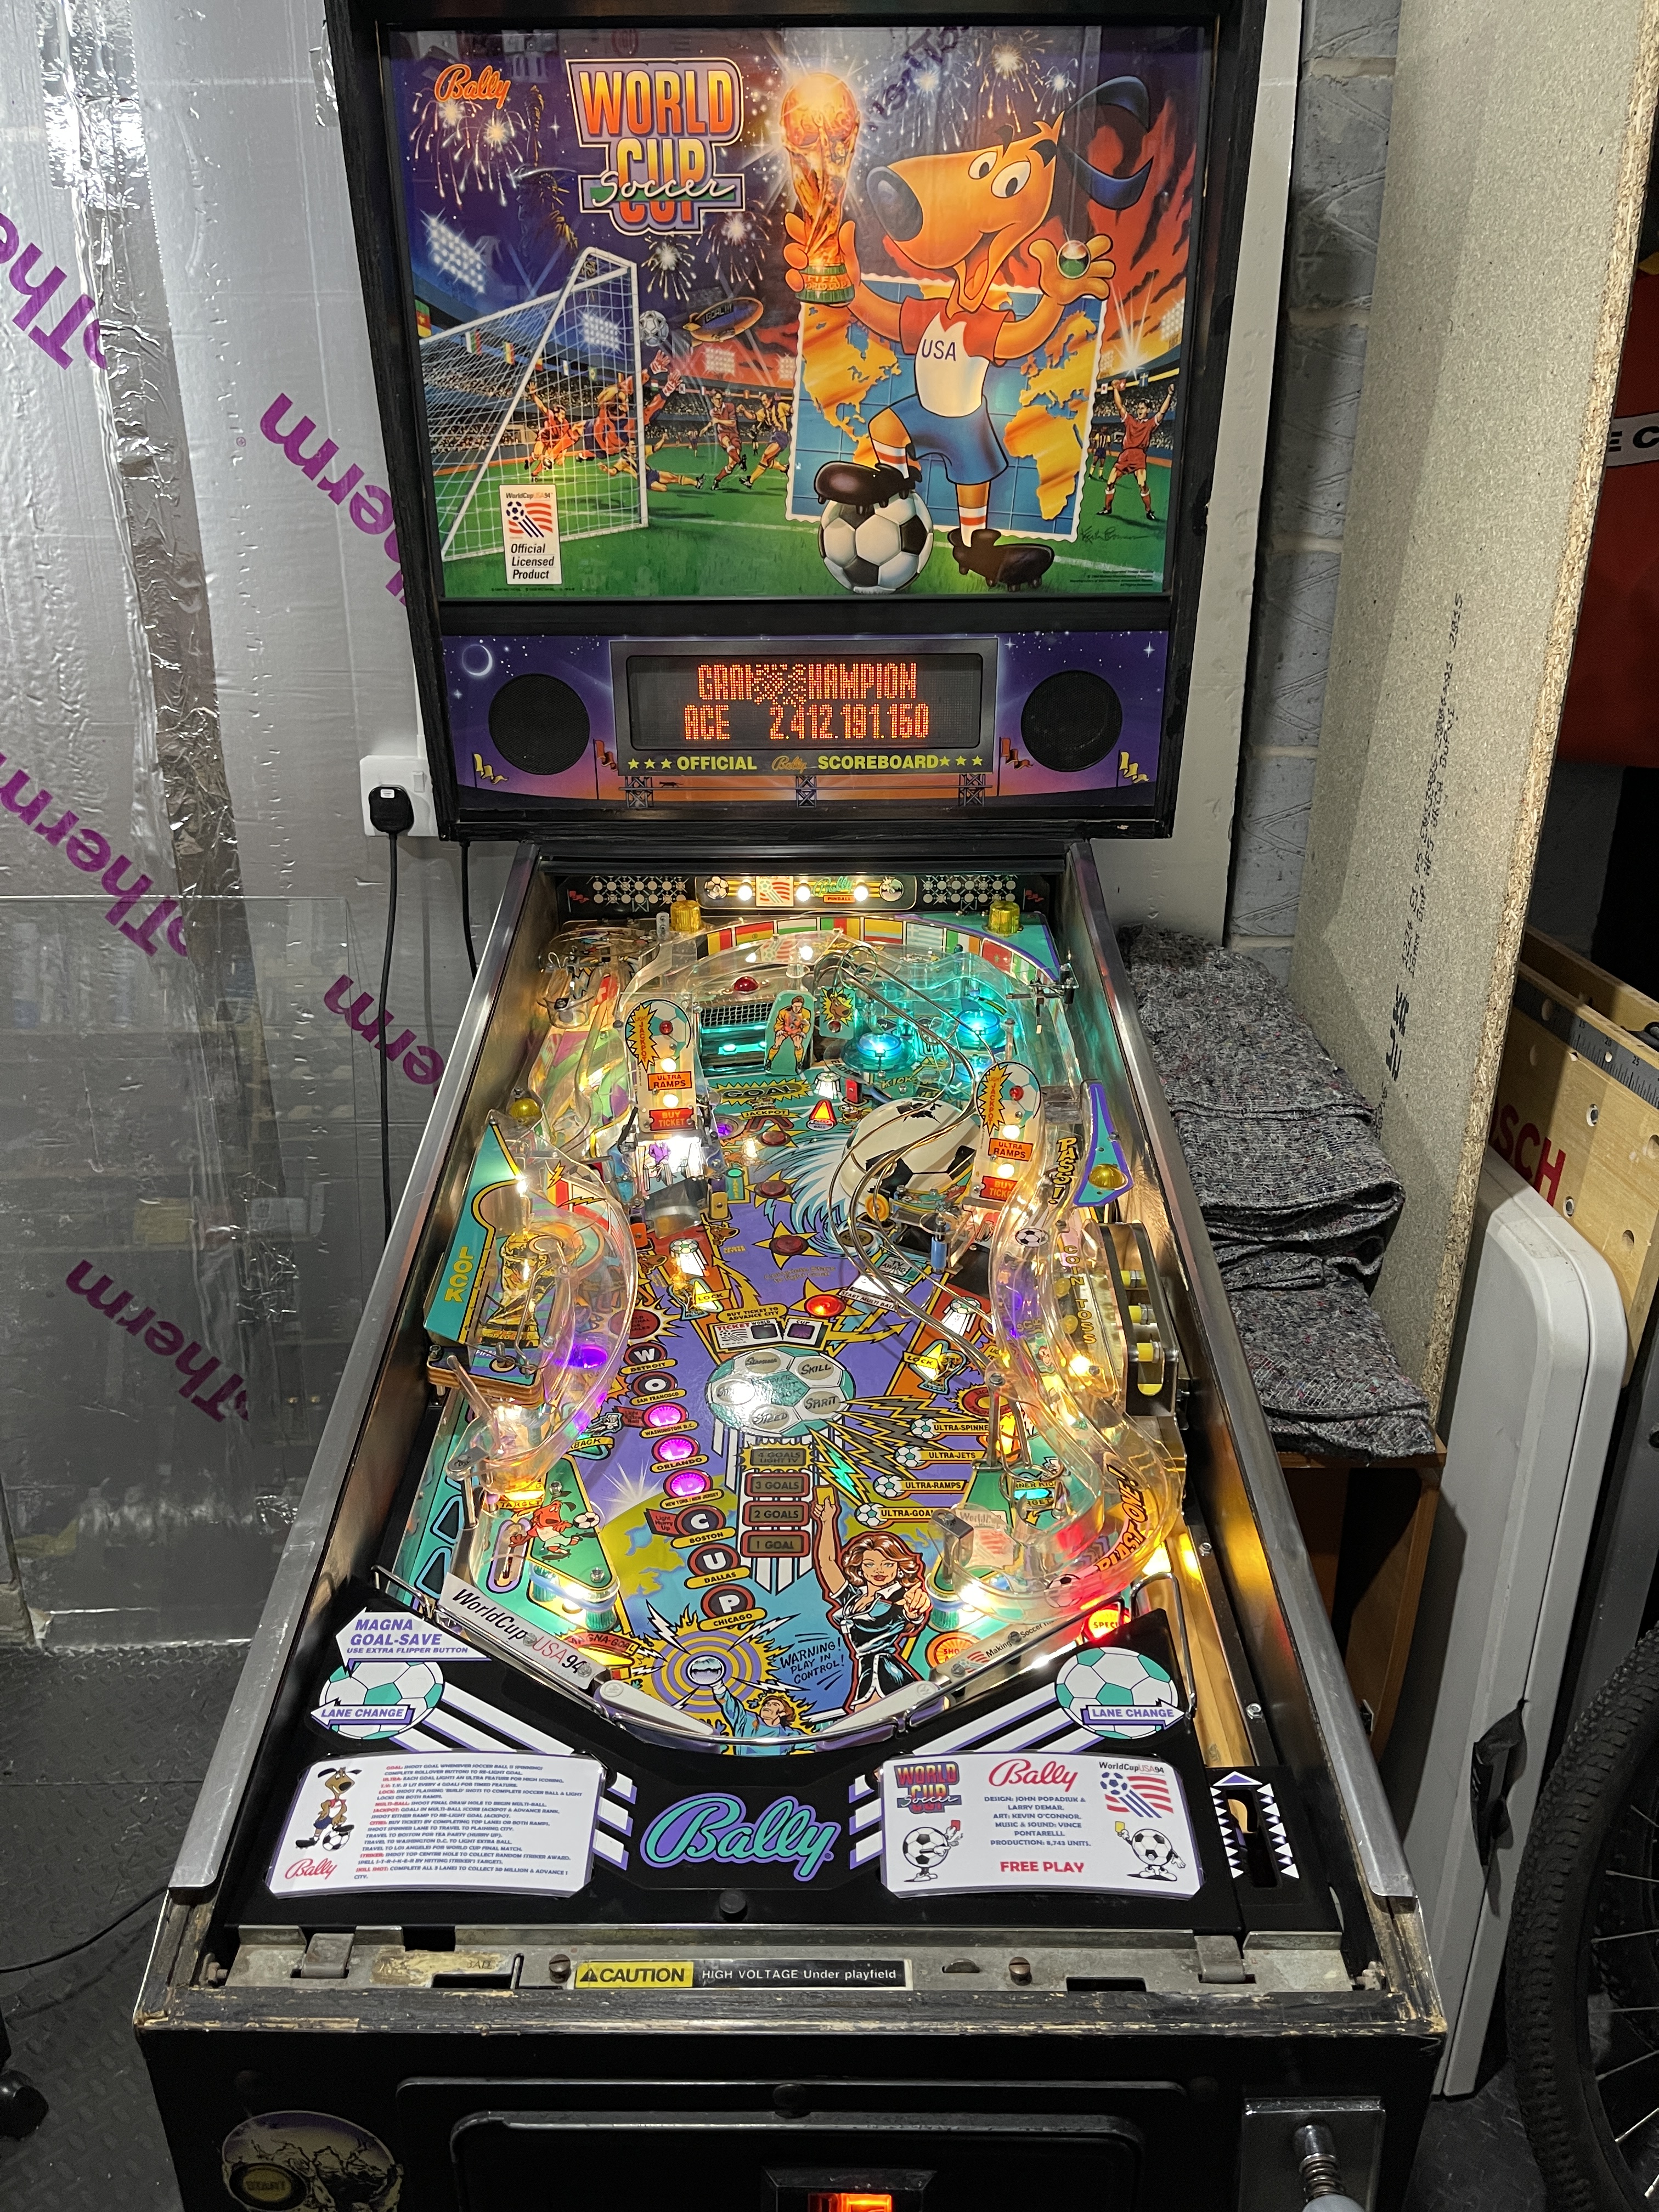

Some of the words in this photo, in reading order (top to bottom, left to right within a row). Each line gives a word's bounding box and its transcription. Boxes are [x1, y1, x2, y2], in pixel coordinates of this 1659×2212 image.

[435, 64, 511, 109] Bally
[578, 70, 734, 136] WORLD
[616, 138, 706, 223] CUP
[592, 171, 737, 207] Soccer
[804, 281, 827, 291] ORLD
[921, 338, 957, 362] USA
[511, 543, 546, 554] Official
[512, 556, 555, 566] Licensed
[512, 569, 549, 579] Product
[685, 704, 730, 740] ACE
[769, 703, 929, 740] 2.412.191.150
[677, 757, 757, 770] OFFICIAL
[771, 755, 806, 773] Bally
[818, 755, 939, 770] SCOREBOARD
[813, 876, 854, 897] Bally
[1579, 1020, 1585, 1029] 15
[639, 1022, 648, 1063] JACKPOT
[1604, 1037, 1612, 1047] 20
[1632, 1056, 1640, 1066] 25
[653, 1080, 686, 1088] RAMPS
[723, 1085, 797, 1099] GOAL
[989, 1083, 997, 1125] JACKPOT
[658, 1118, 686, 1127] TICKET
[998, 1141, 1023, 1150] ULTRA
[1489, 1097, 1566, 1207] SCH
[994, 1148, 1026, 1159] RAMPS
[1048, 1137, 1078, 1205] PASS!
[994, 1181, 1014, 1190] BUY
[882, 1263, 906, 1272] AWARD
[1063, 1244, 1085, 1286] COIN
[444, 1246, 473, 1303] LOCK
[697, 1292, 724, 1301] LOCK
[840, 1291, 860, 1302] START
[860, 1296, 879, 1306] MULTI
[1075, 1298, 1097, 1345] TOSS
[634, 1348, 655, 1363] W
[907, 1355, 934, 1366] LOCK
[630, 1362, 665, 1372] DETROIT
[801, 1364, 831, 1375] SKILL
[645, 1378, 666, 1392] O
[650, 1392, 679, 1402] FRANCISCO
[805, 1396, 838, 1409] SPIRIT
[645, 1426, 682, 1436] WASHINGTON
[656, 1457, 703, 1470] ORLANDO
[755, 1481, 761, 1489] 3
[765, 1481, 799, 1489] GOALS
[754, 1510, 760, 1519] 2
[764, 1510, 799, 1519] GOALS
[881, 1509, 933, 1517] ULTRA-GOA
[690, 1513, 709, 1530] C
[690, 1531, 724, 1544] BOSTON
[765, 1541, 794, 1549] GOAL
[703, 1551, 726, 1571] U
[703, 1571, 737, 1583] DALLAS
[718, 1594, 740, 1613] P
[452, 1588, 528, 1640] WorldCup
[713, 1612, 753, 1627] CHICAGO
[355, 1619, 413, 1631] MAGNA
[350, 1633, 443, 1646] GOAL-SAVE
[986, 1640, 1012, 1658] Making
[1020, 1626, 1043, 1639] Soccer
[780, 1637, 841, 1669] WARNING!
[790, 1658, 815, 1674] PLAY
[820, 1652, 831, 1663] IN
[794, 1654, 844, 1684] CONTROL!
[320, 1708, 353, 1718] LANE
[354, 1708, 404, 1718] CHANGE
[1092, 1708, 1124, 1718] LANE
[1125, 1708, 1175, 1719] CHANGE
[897, 1764, 957, 1785] WORLD
[988, 1759, 1079, 1793] Bally
[901, 1795, 959, 1807] Soccer
[910, 1783, 949, 1812] CUP
[642, 1794, 839, 1880] Bally
[284, 1858, 338, 1880] Bally
[1000, 1861, 1040, 1872] FREE
[1042, 1861, 1085, 1873] PLAY
[600, 1967, 685, 1983] CAUTION
[702, 1970, 733, 1980] HIGH
[738, 1970, 798, 1980] VOLTAGE
[803, 1969, 839, 1980] Under
[844, 1969, 897, 1983] playfield
